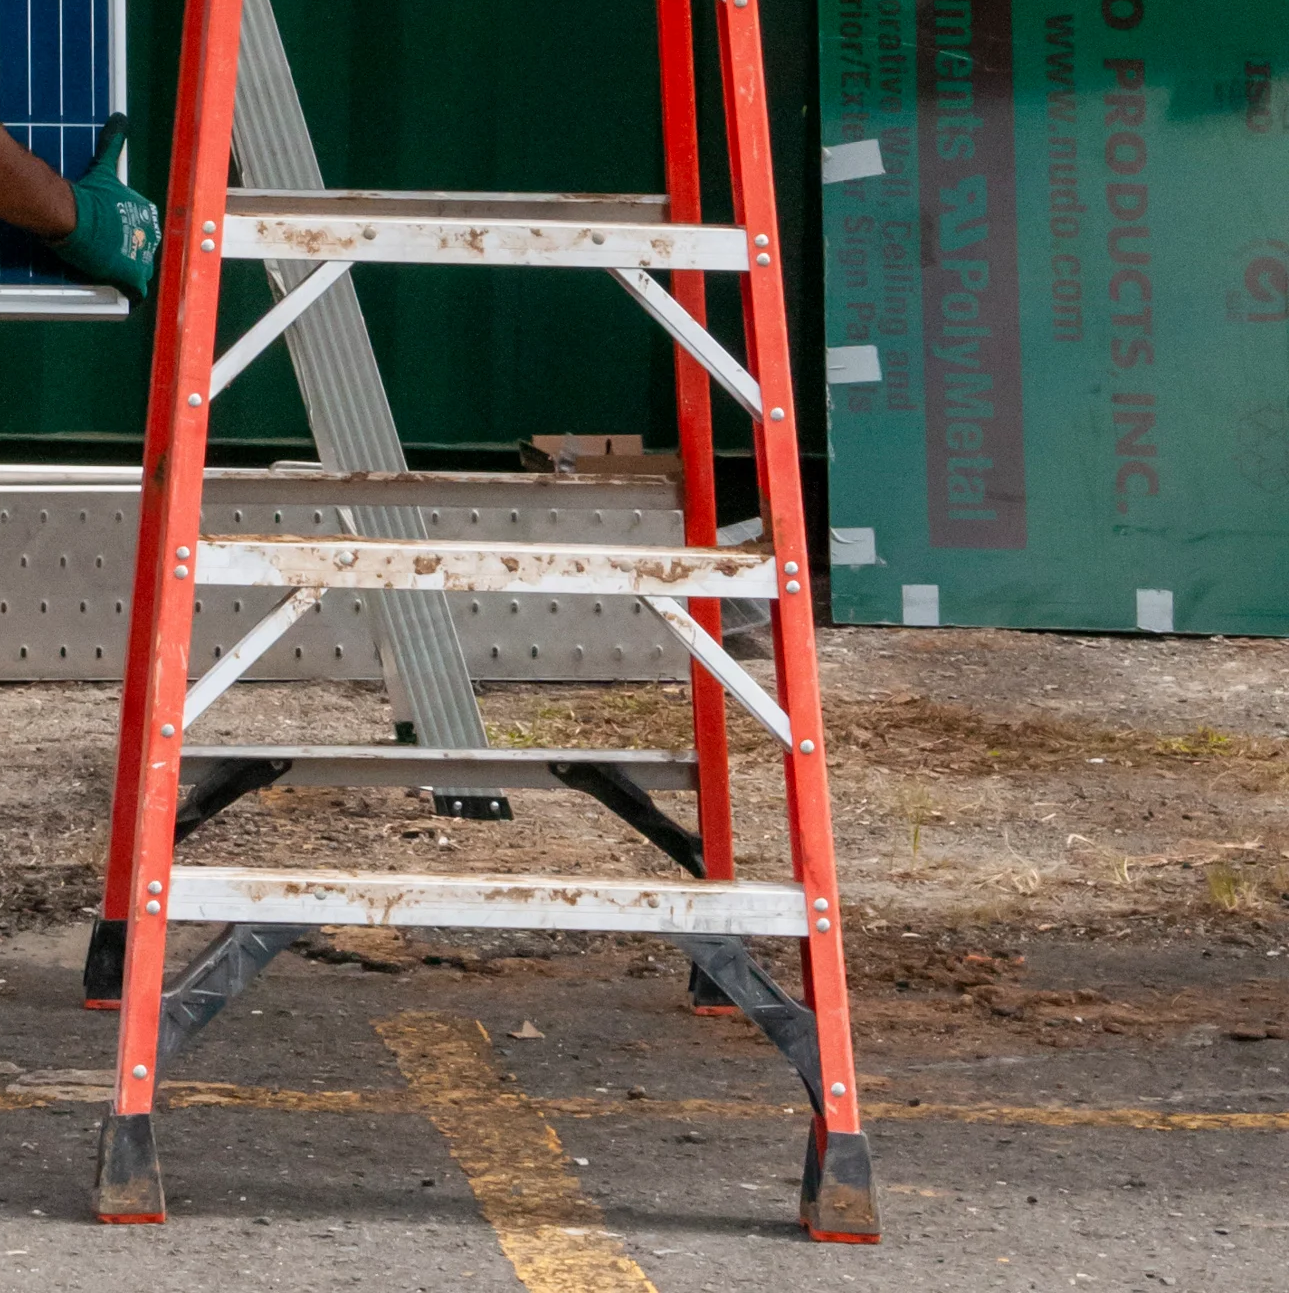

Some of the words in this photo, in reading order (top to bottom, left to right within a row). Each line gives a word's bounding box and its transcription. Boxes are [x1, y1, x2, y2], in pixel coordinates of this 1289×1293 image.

[1243, 59, 1272, 134] ISO
[1045, 15, 1088, 343] www.nudo.com
[838, 214, 876, 289] Sign
[878, 219, 914, 336] Ceiling
[846, 302, 879, 414] Pals
[885, 349, 918, 412] and
[931, 258, 998, 522] PolyMetal
[1112, 392, 1160, 513] INC.
